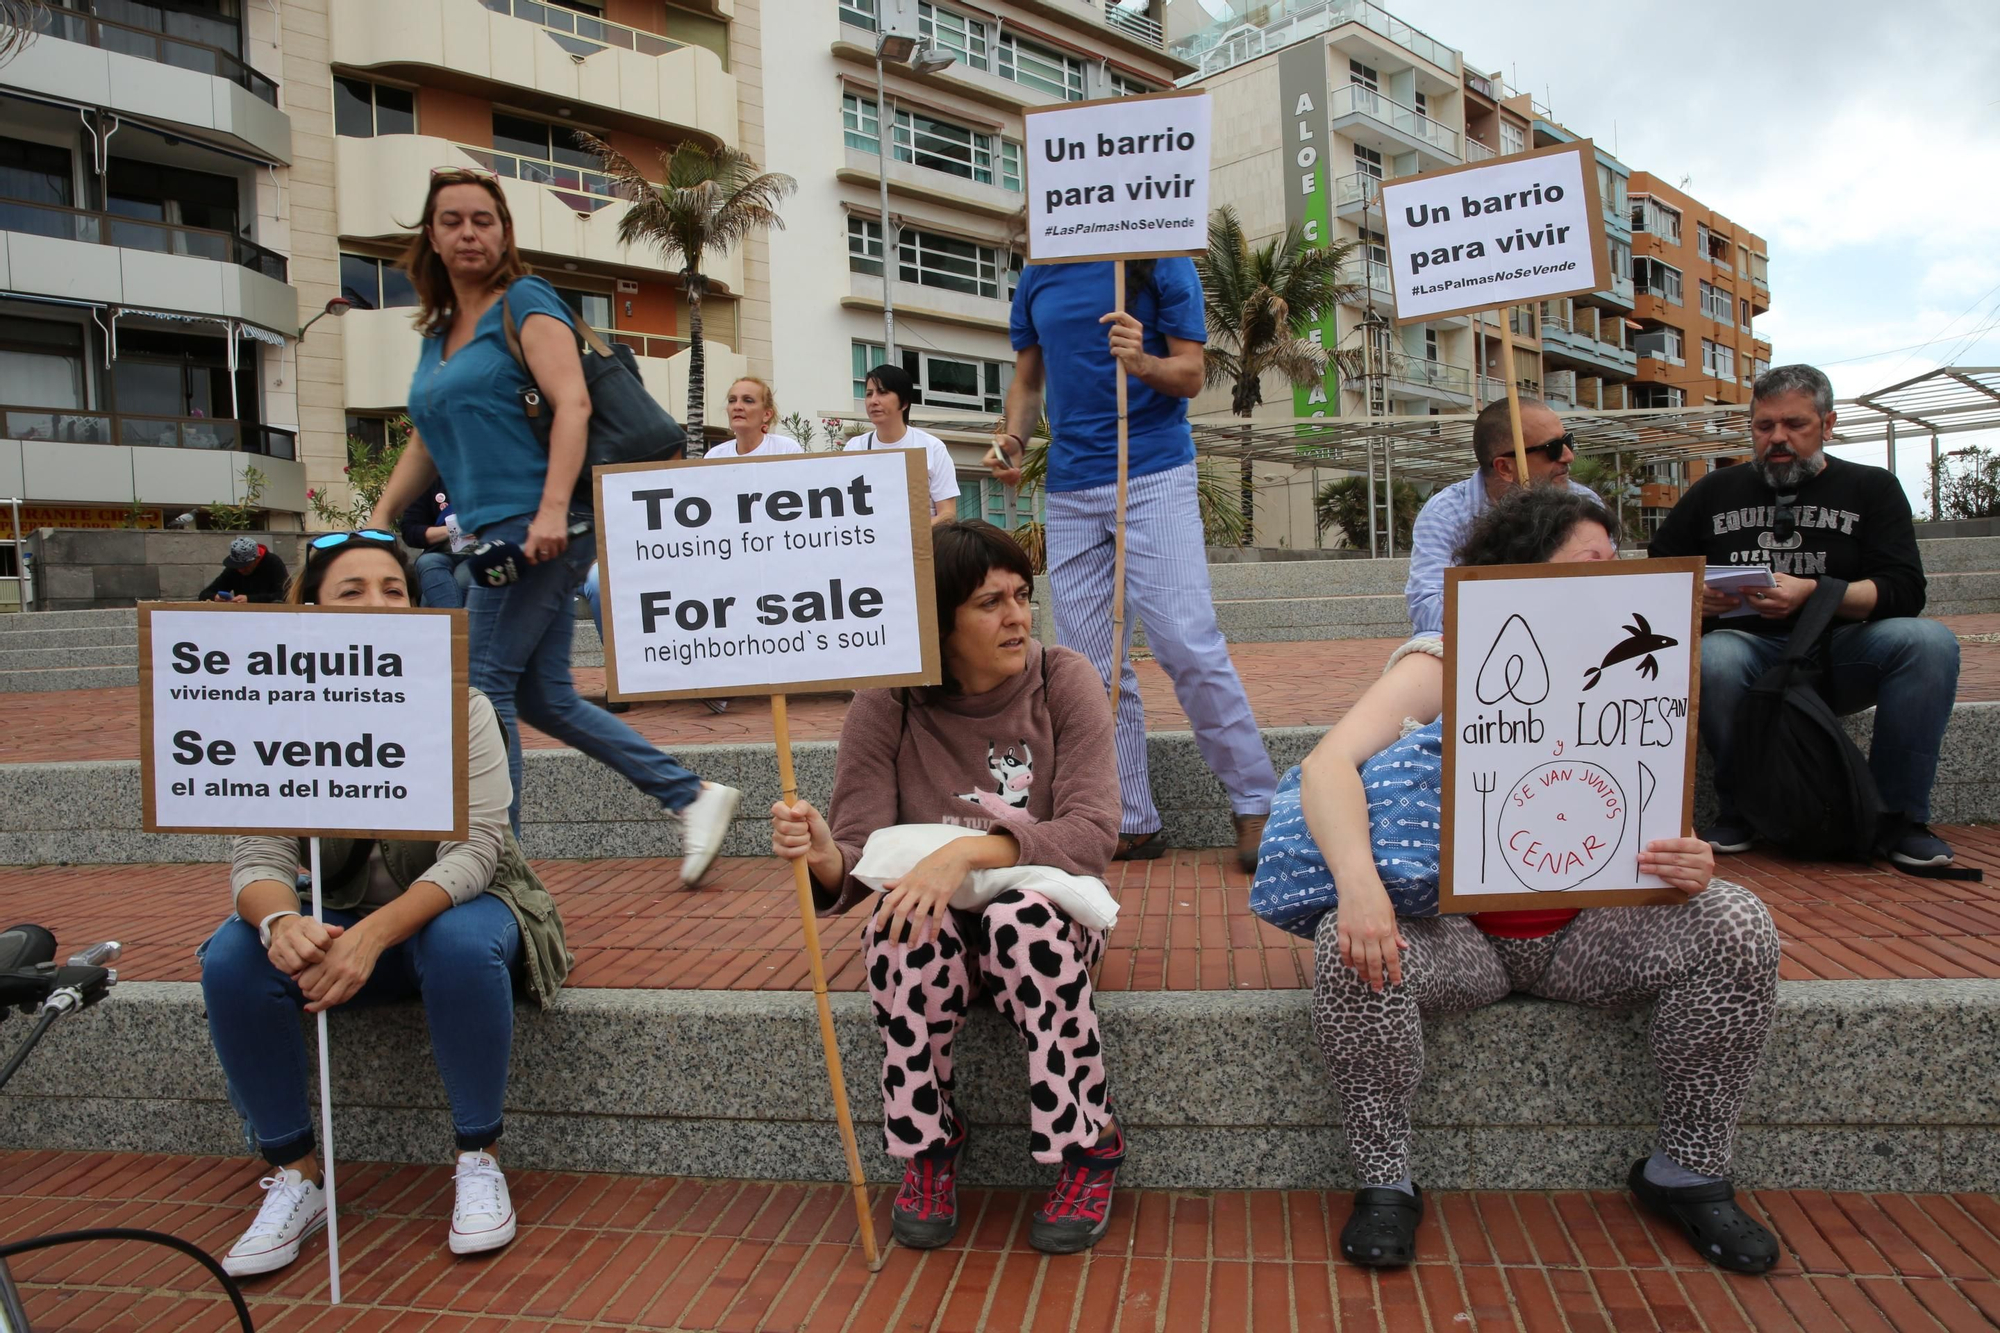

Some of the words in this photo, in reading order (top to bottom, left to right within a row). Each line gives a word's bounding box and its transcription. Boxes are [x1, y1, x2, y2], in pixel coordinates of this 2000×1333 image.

[1044, 137, 1085, 163] Un
[1097, 126, 1195, 158] barrio
[1294, 92, 1317, 196] ALOE
[1046, 184, 1115, 214] para
[1125, 173, 1195, 201] vivir
[1405, 203, 1451, 228] Un
[1461, 182, 1564, 218] barrio
[1044, 217, 1195, 237] #LasPalmasNoSeVende
[1410, 241, 1486, 275] para
[1495, 223, 1571, 254] vivir
[1411, 260, 1577, 297] #LasPalmasNoSeVende
[631, 487, 712, 531] To
[736, 474, 874, 525] rent
[1712, 505, 1860, 535] EQUIENT
[636, 535, 732, 561] housing
[741, 531, 775, 553] for
[783, 525, 876, 550] tourists
[1730, 550, 1771, 562] OVER
[639, 590, 737, 634] For
[756, 578, 885, 626] sale
[838, 624, 887, 649] soul
[171, 641, 231, 675] Se
[247, 643, 403, 684] alquila
[169, 684, 261, 701] vivienda
[268, 690, 316, 706] para
[322, 687, 406, 704] turistas
[1462, 707, 1545, 745] airbnb
[172, 729, 237, 766] Se
[253, 732, 406, 769] vende
[1552, 739, 1564, 757] y
[171, 777, 195, 796] el
[204, 778, 270, 797] alma
[279, 779, 319, 798] del
[328, 779, 408, 800] barrio
[1513, 783, 1535, 807] SE
[1539, 768, 1573, 787] VAN
[1579, 768, 1622, 820] JUNTOS
[1556, 811, 1567, 822] a
[1509, 830, 1606, 875] CENAR
